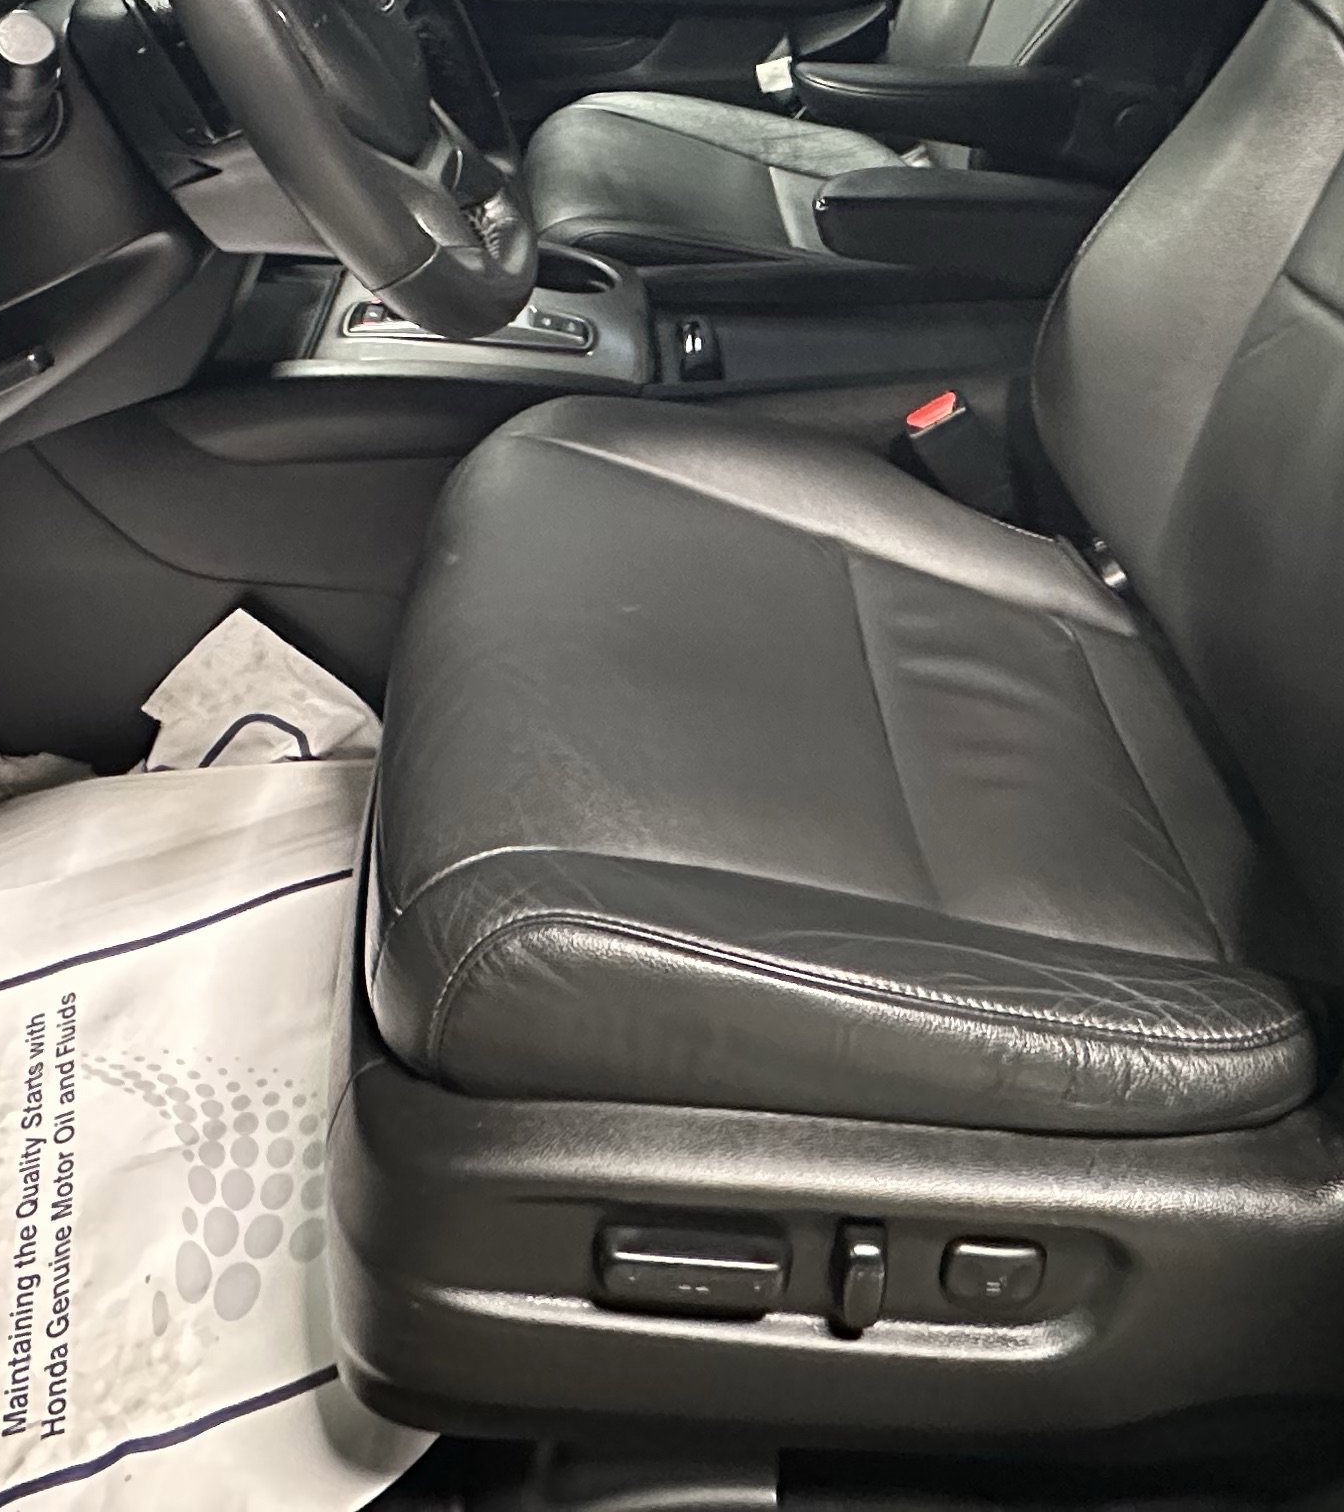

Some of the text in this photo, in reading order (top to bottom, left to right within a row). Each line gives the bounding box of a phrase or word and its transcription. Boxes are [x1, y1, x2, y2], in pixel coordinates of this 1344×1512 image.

[1, 1012, 48, 1438] Maintaining the Quality Starts with
[40, 991, 77, 1441] Honda Genuine Motor Oil and Fluids
